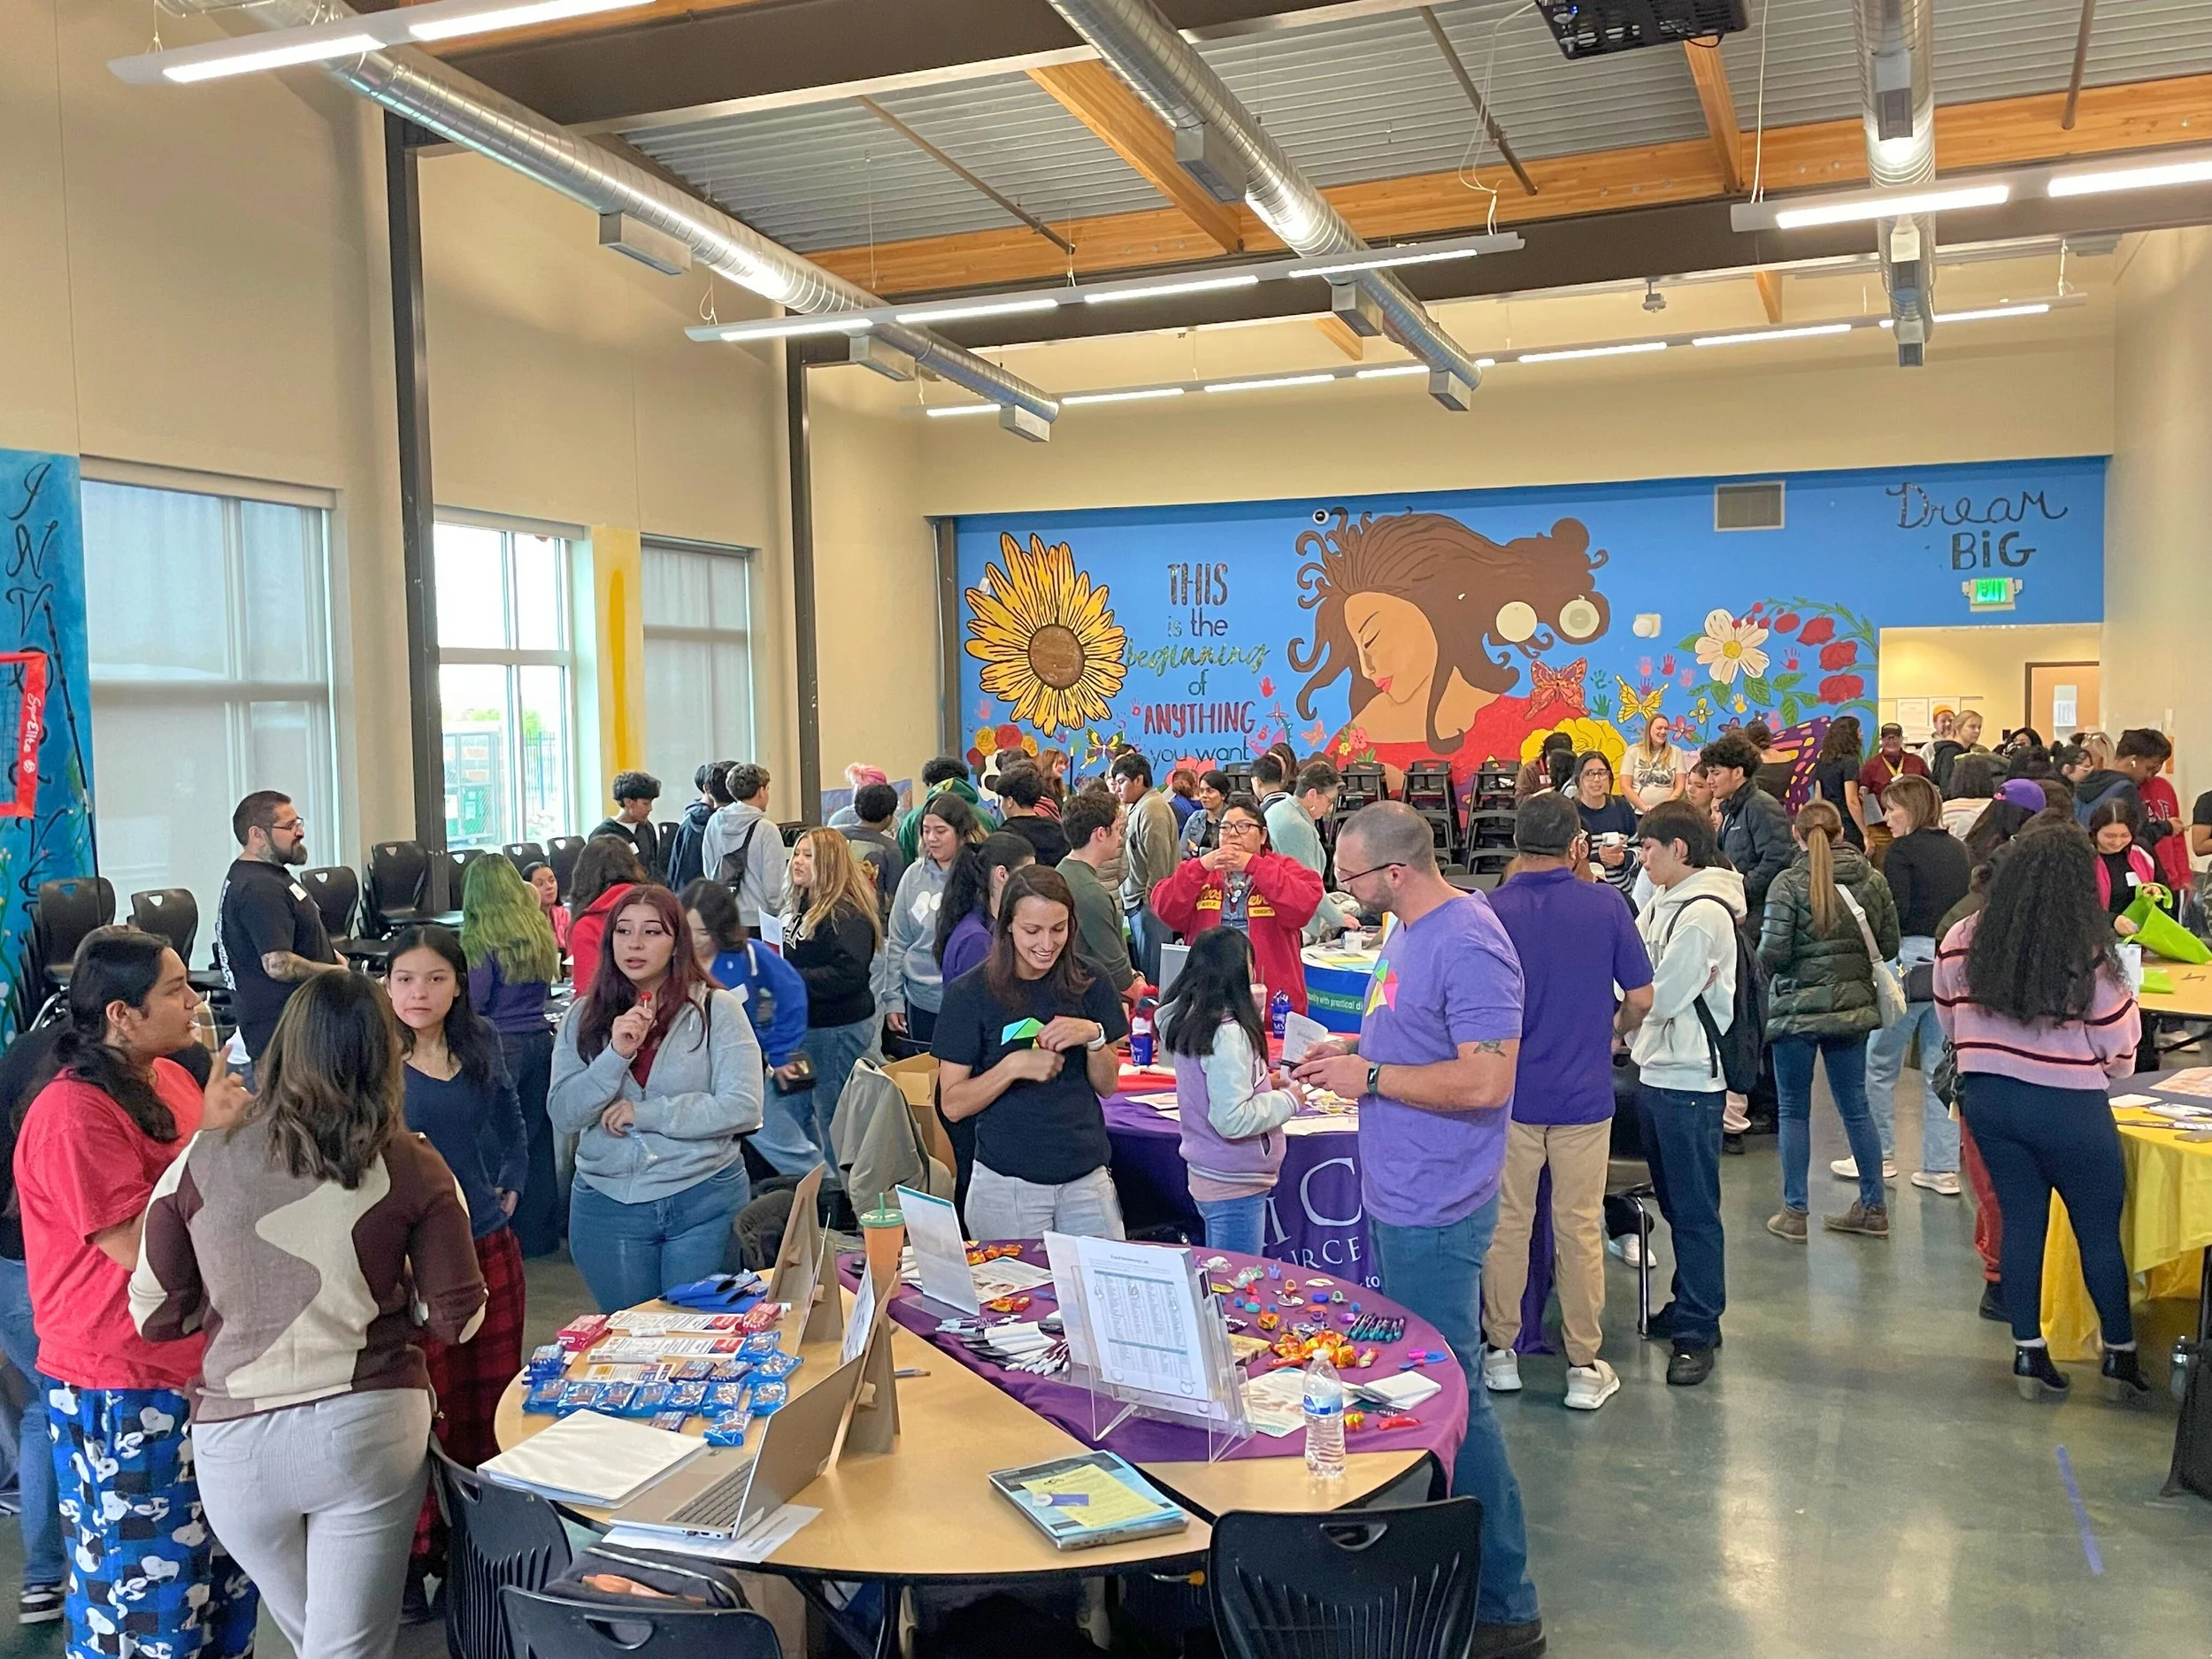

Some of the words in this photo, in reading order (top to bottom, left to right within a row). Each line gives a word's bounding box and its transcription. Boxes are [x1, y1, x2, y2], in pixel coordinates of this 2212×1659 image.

[1167, 562, 1228, 606] THIS
[1977, 579, 2008, 602] EXIT
[1167, 615, 1183, 638] is
[1190, 607, 1228, 637] the
[1126, 637, 1271, 678] beginning
[1187, 669, 1210, 696] of
[1143, 701, 1256, 739] ANYTHING
[1150, 747, 1187, 771] you
[1194, 735, 1250, 762] want
